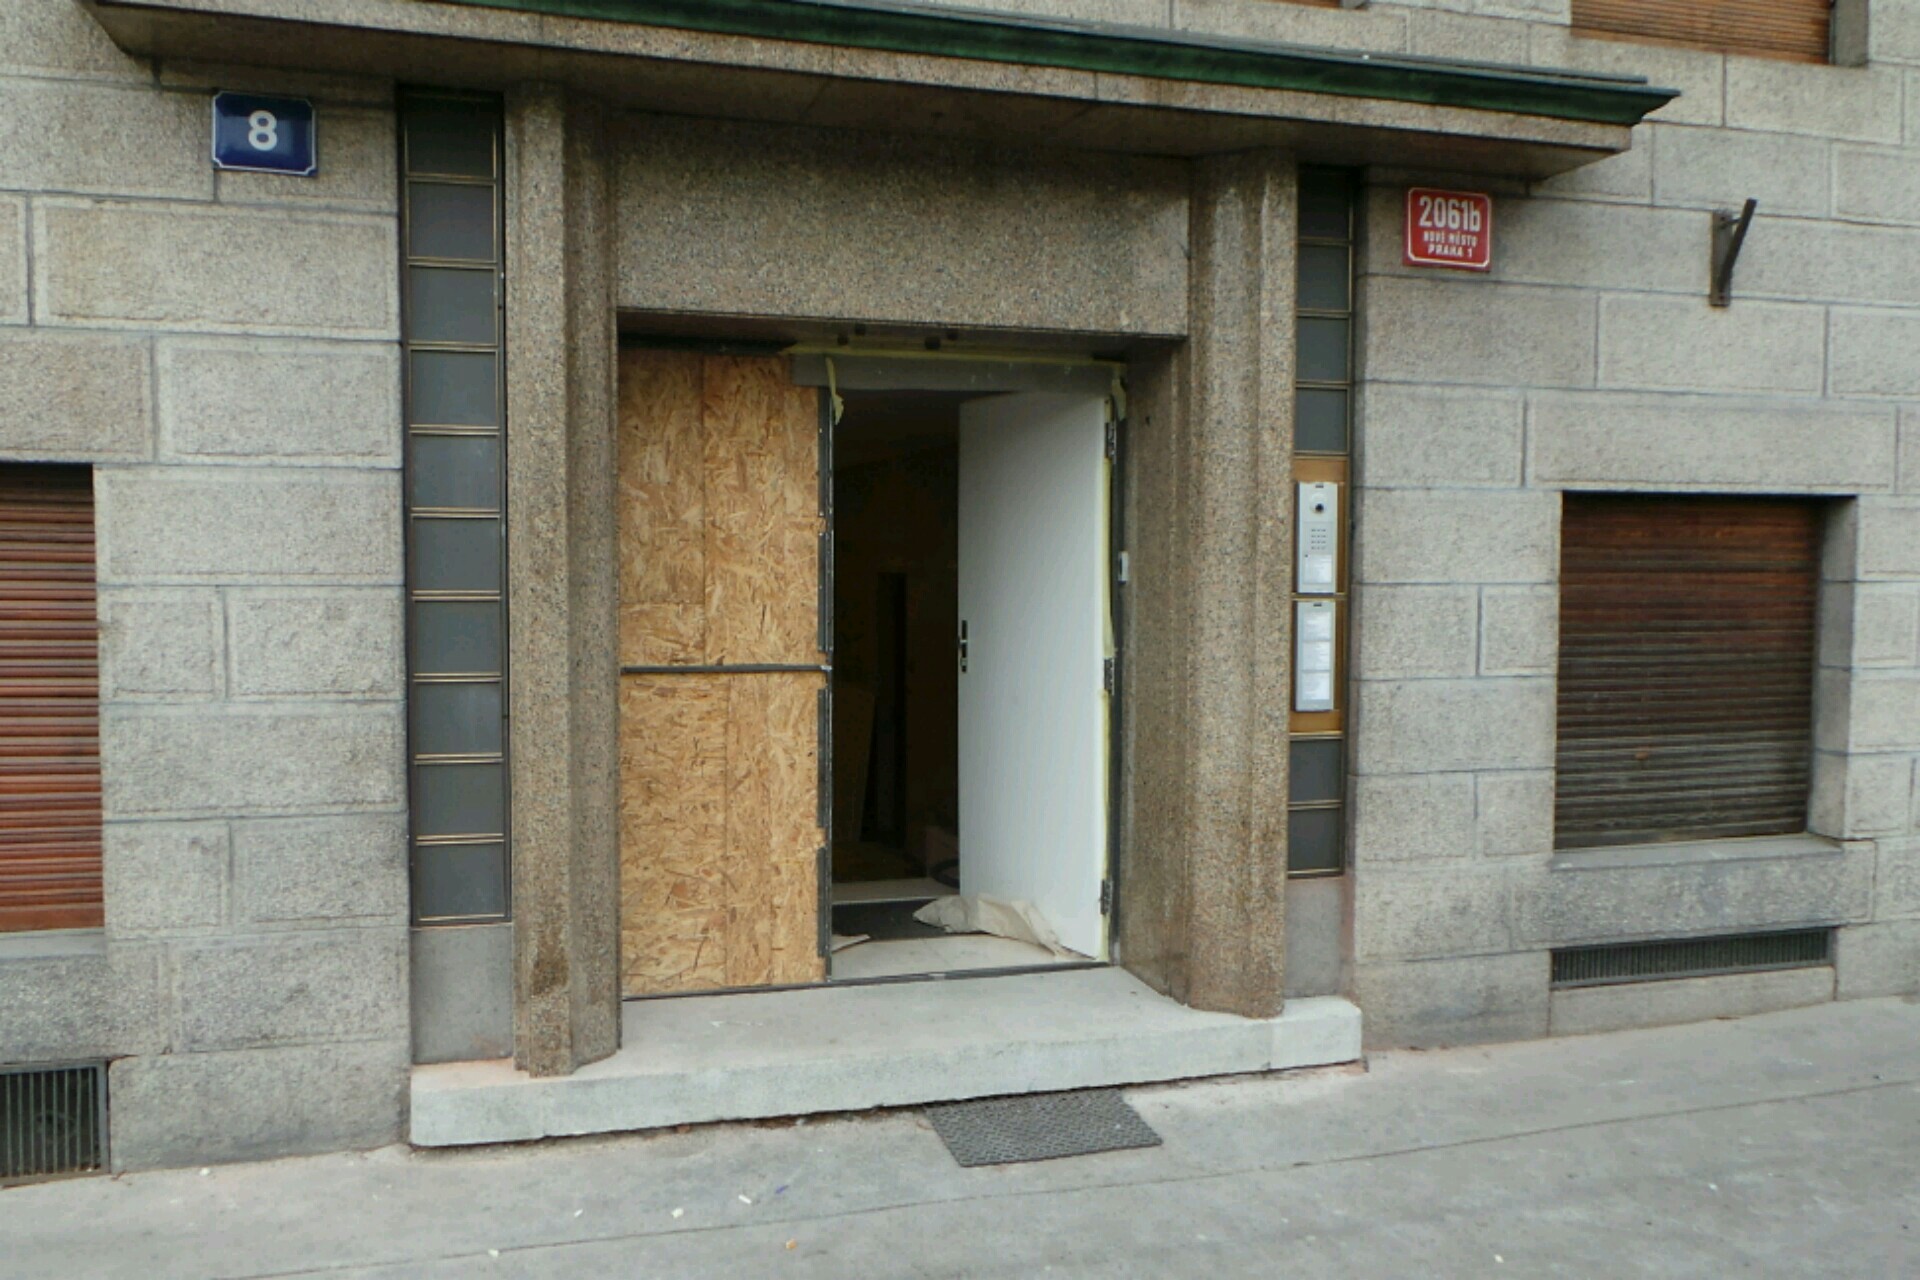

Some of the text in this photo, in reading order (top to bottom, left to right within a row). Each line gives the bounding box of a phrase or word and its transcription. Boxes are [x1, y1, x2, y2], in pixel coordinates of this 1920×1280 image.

[248, 109, 278, 151] 8
[1419, 196, 1481, 232] 2061b
[1427, 243, 1473, 259] PRAHA 1
